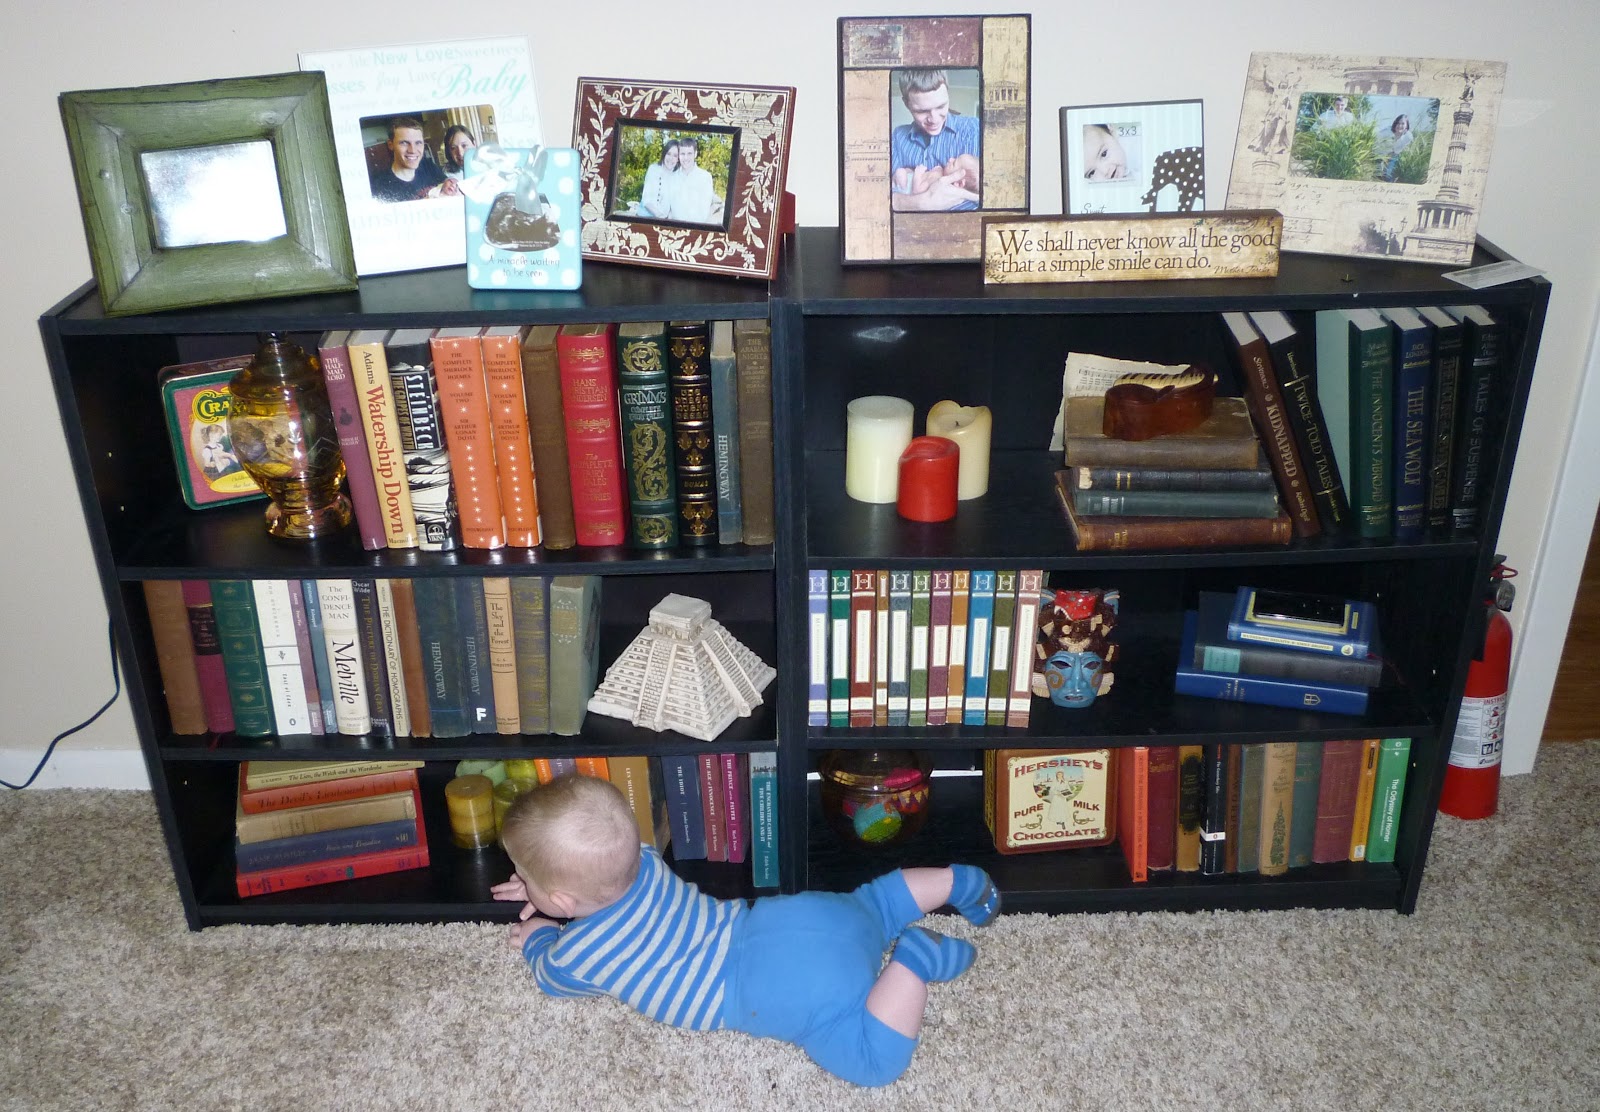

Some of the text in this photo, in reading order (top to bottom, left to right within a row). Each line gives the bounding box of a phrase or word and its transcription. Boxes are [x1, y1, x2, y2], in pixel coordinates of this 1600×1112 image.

[371, 50, 408, 66] New
[415, 46, 455, 64] Love
[431, 59, 528, 107] Baby
[1118, 126, 1138, 137] 3x3
[996, 225, 1276, 256] We shall never know all the good
[496, 255, 528, 267] miracle
[529, 257, 561, 269] waiting
[1001, 248, 1212, 278] that a simple smile can do.
[503, 268, 543, 279] to be seen
[325, 357, 340, 365] THE
[362, 349, 376, 386] Adams
[326, 374, 346, 382] LORD
[572, 378, 597, 388] HANS
[1371, 368, 1384, 390] THE
[623, 390, 667, 406] GRIMM'S
[1472, 373, 1490, 413] TALES
[405, 374, 435, 450] STEINBECK
[1370, 393, 1383, 455] INNOCENTS
[1470, 415, 1486, 435] OF
[1266, 404, 1297, 478] KIDNAPPED
[1294, 383, 1320, 457] TWICE-TOLD
[1316, 455, 1334, 489] TALES
[1403, 385, 1424, 487] THE SEA WOLF
[365, 384, 404, 534] Watership Down
[716, 433, 731, 502] HEMINGWAY
[1371, 456, 1382, 503] ABROAD
[1461, 436, 1482, 503] SUSPENSE
[427, 534, 446, 542] VIKING
[352, 580, 371, 588] Oscar
[321, 593, 351, 602] CONFI-
[322, 602, 353, 611] DENCE
[490, 603, 504, 611] The
[328, 612, 350, 620] MAN
[491, 611, 504, 621] Sky
[492, 620, 505, 628] and
[490, 636, 510, 645] Forest
[493, 628, 504, 636] the
[332, 636, 360, 705] Melville
[381, 605, 403, 721] THE DICTIONARY OF HOMOGRAPHS
[430, 641, 447, 701] HEMINGWAY
[465, 635, 481, 696] HEMINGWAY
[475, 707, 488, 722] F
[288, 774, 299, 782] The
[299, 772, 313, 781] Lion,
[322, 769, 337, 778] Witch
[337, 768, 349, 776] and
[357, 764, 383, 774] Wardrobe
[1013, 757, 1105, 779] HERSHEY'S
[676, 765, 687, 796] THE IDIOT
[257, 796, 276, 810] The
[279, 792, 313, 806] Devil's
[708, 785, 716, 817] INNOCENCE
[1013, 801, 1045, 819] PURE
[1072, 799, 1101, 812] MILK
[1387, 790, 1398, 814] Odyssey
[1386, 814, 1393, 822] of
[1012, 827, 1101, 842] CHOCOLATE
[1383, 822, 1392, 843] Homer
